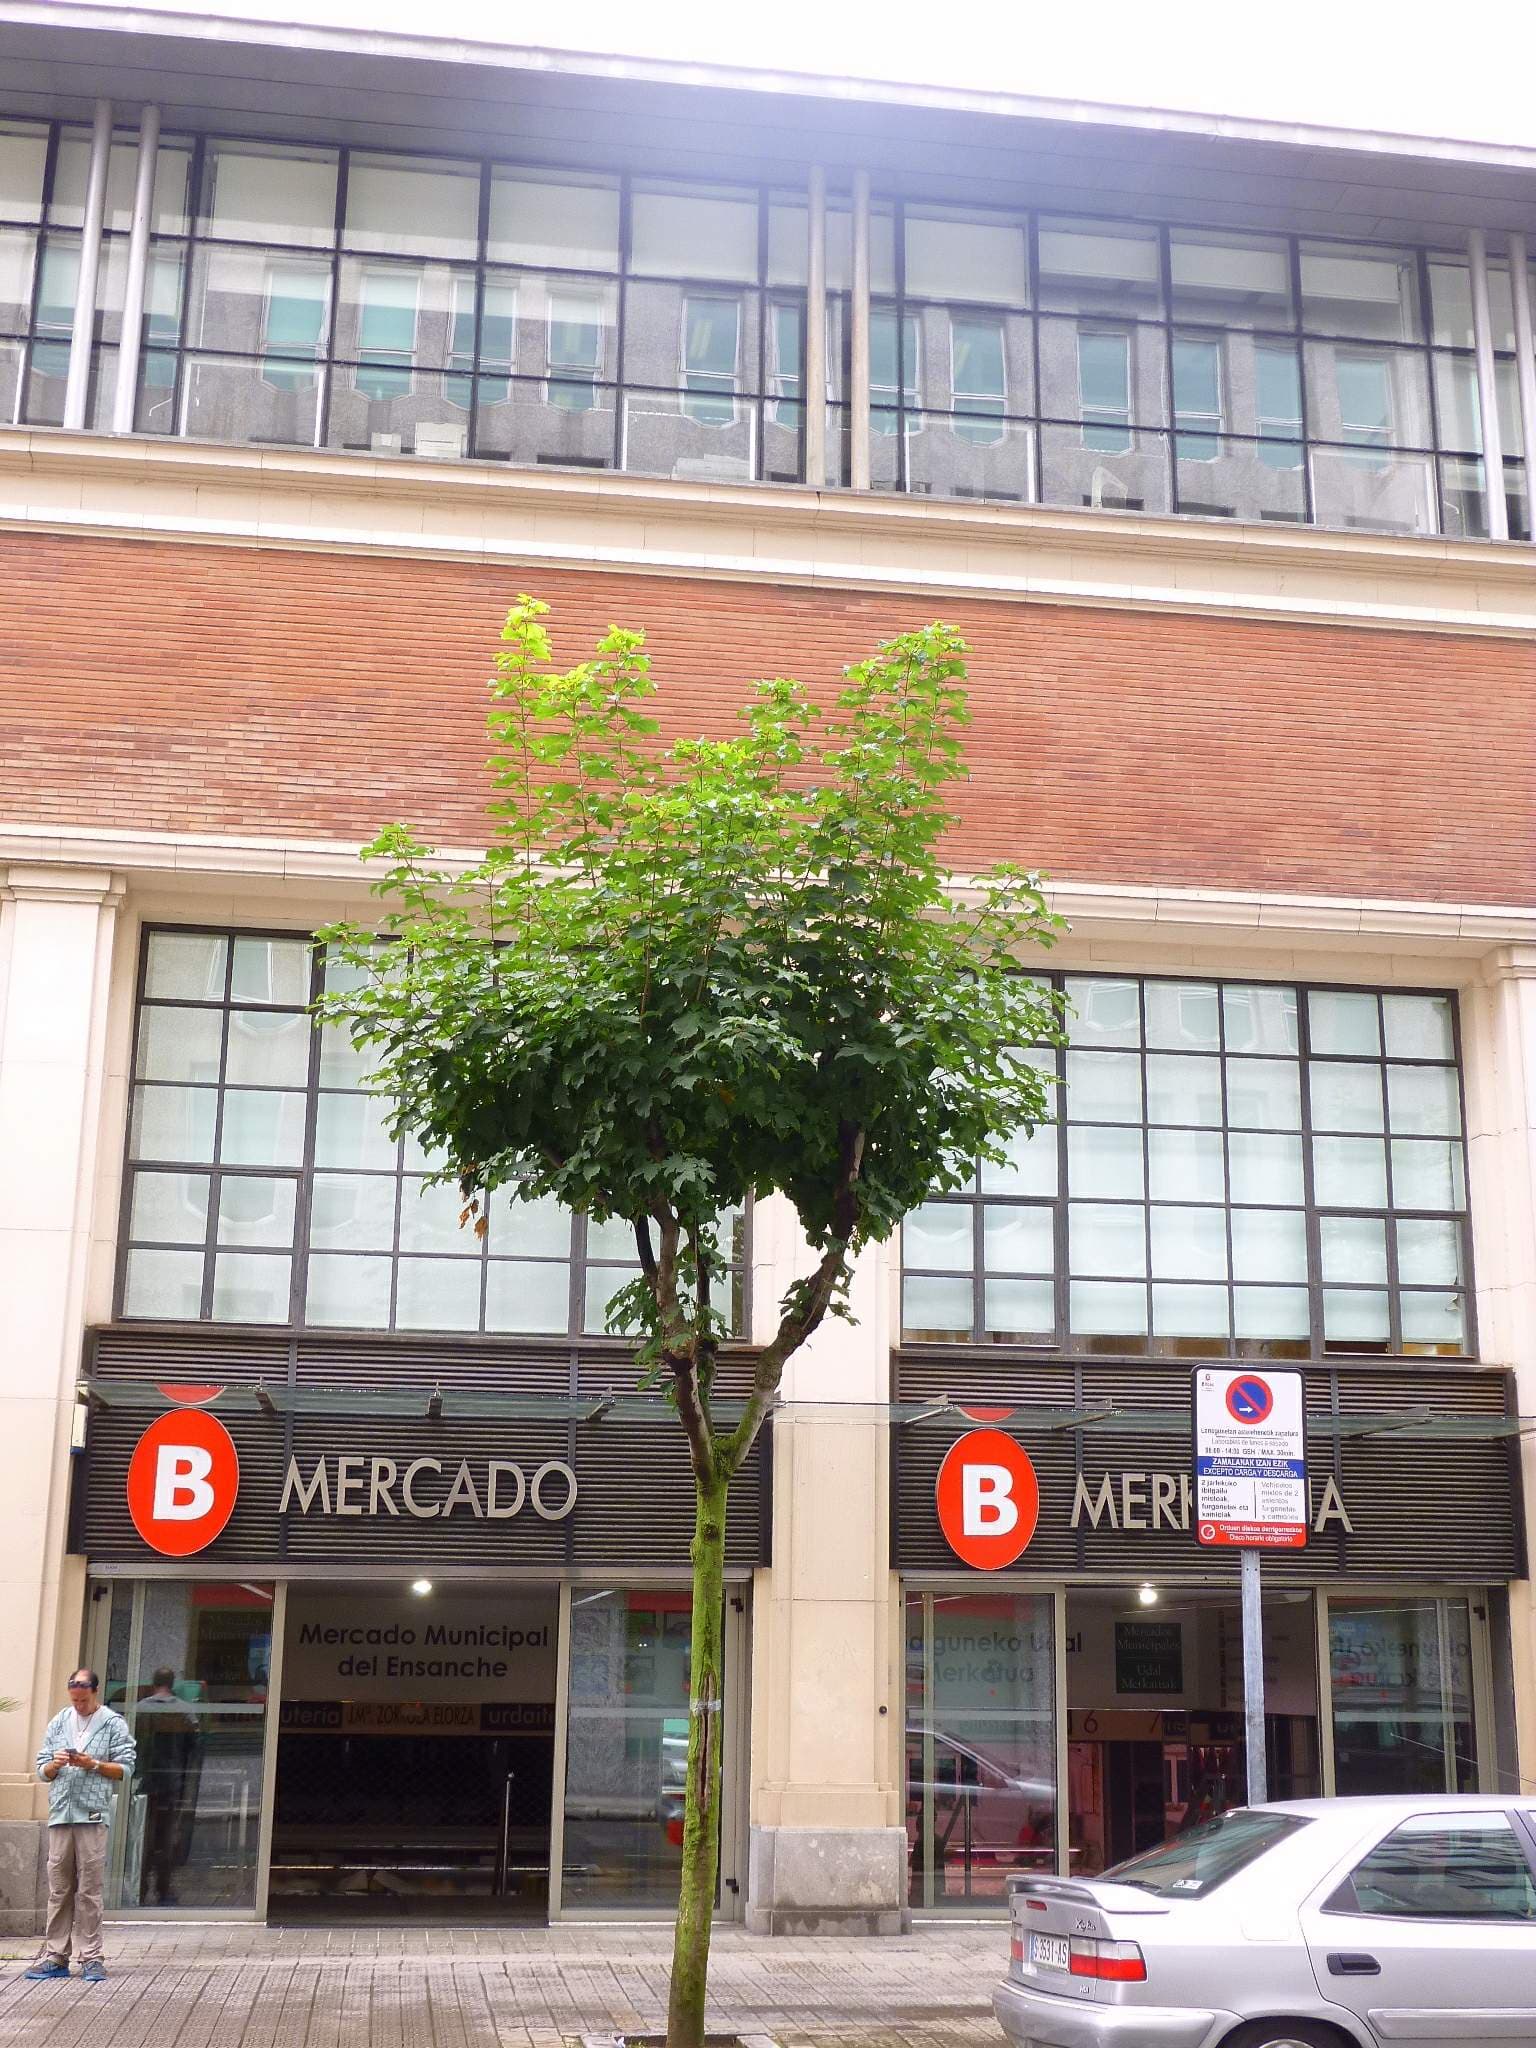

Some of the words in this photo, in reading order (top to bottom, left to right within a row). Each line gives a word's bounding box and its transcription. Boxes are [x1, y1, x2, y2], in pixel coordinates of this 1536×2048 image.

[1203, 1467, 1233, 1475] EXCEPTO
[1234, 1468, 1256, 1476] CARGA
[1263, 1469, 1297, 1478] DESCARGA
[1212, 1457, 1254, 1466] ZAMALANAK
[1256, 1458, 1271, 1467] IZAN
[1273, 1459, 1288, 1468] EZIK
[152, 1444, 214, 1521] B
[278, 1454, 577, 1521] MERCADO
[962, 1464, 1018, 1536] B
[300, 1624, 416, 1645] Mercado
[424, 1625, 549, 1650] Municipal
[338, 1656, 378, 1676] del
[386, 1656, 509, 1677] Ensanche
